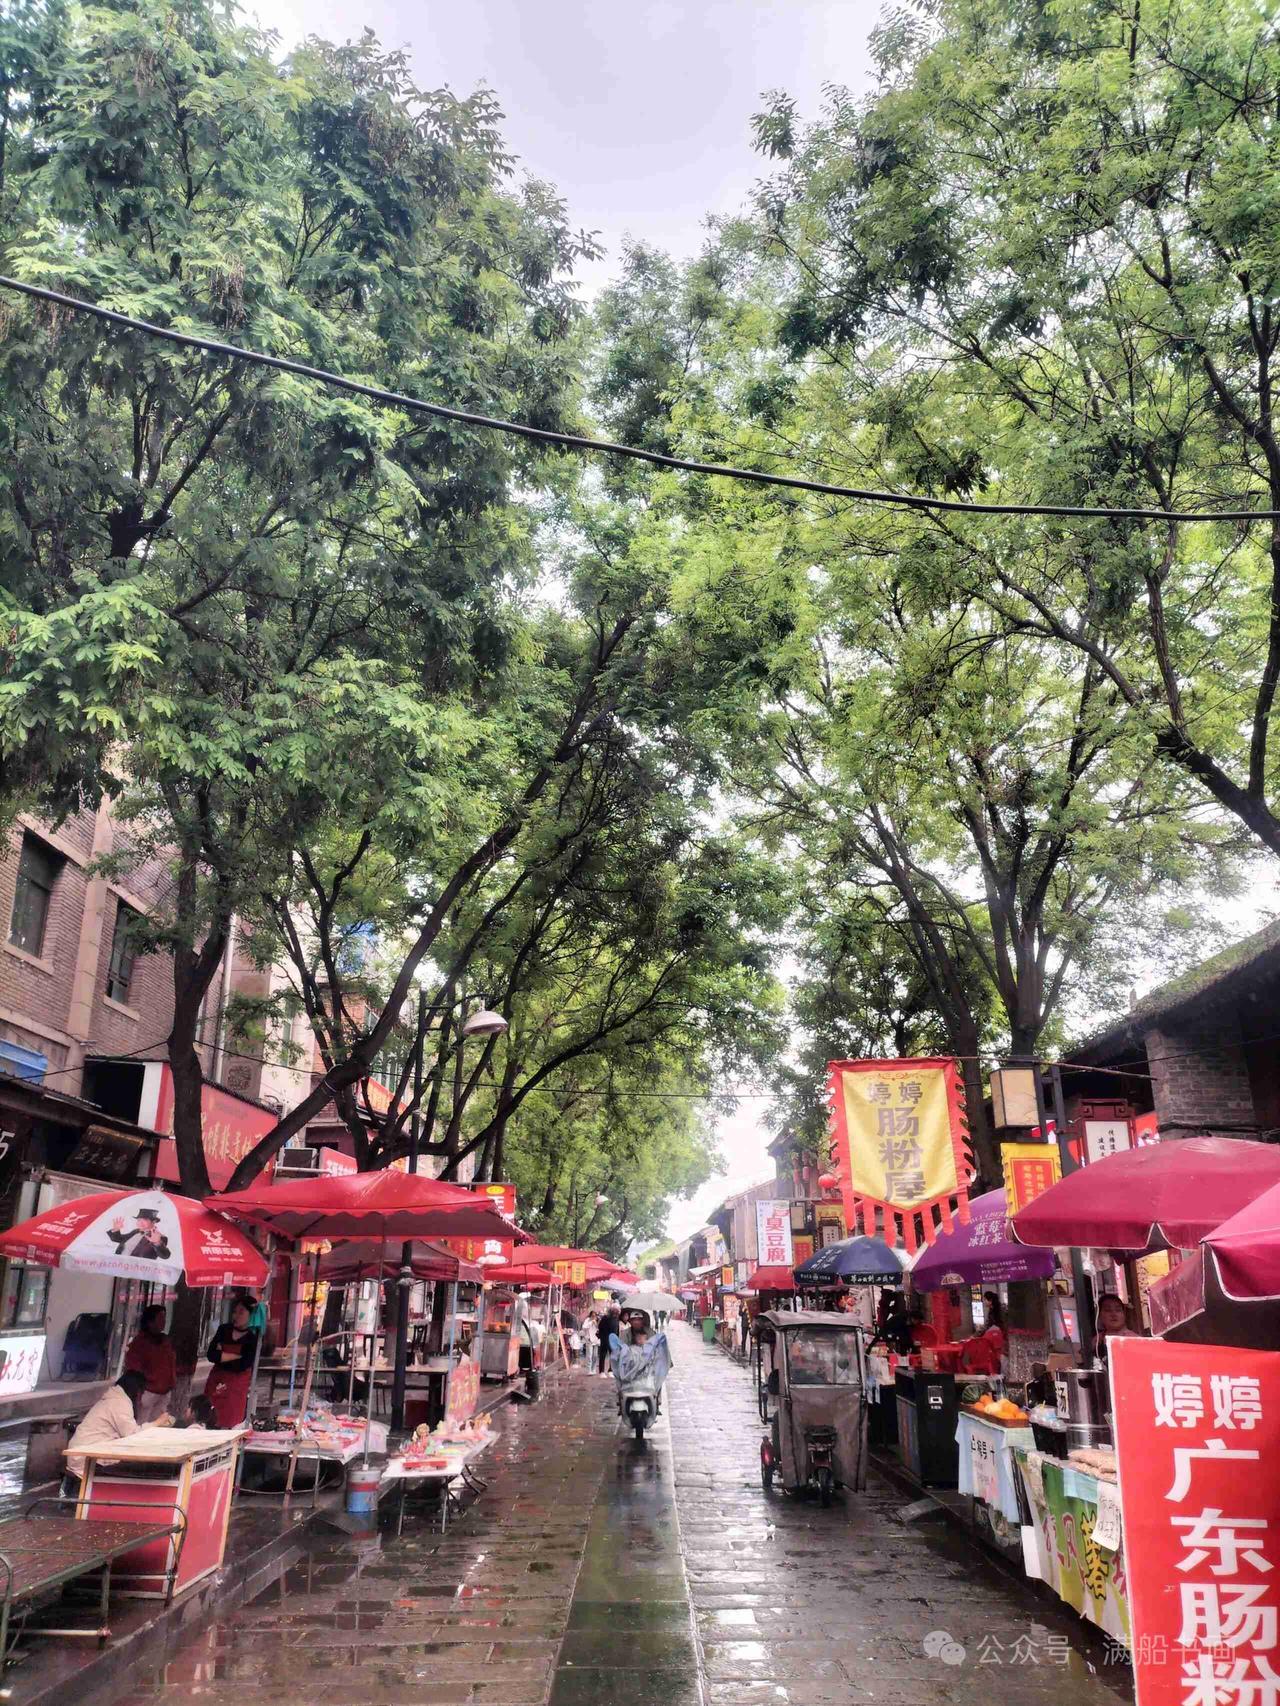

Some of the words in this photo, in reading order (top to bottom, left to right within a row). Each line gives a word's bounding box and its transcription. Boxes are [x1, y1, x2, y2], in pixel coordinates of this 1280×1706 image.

[868, 1081, 923, 1105] 婷婷
[877, 1107, 926, 1201] 肠粉屋
[766, 1217, 785, 1262] 臭豆腐
[968, 1233, 1003, 1248] 冰红茶
[1151, 1372, 1263, 1430] 婷婷
[1164, 1438, 1280, 1706] 广东肠粉
